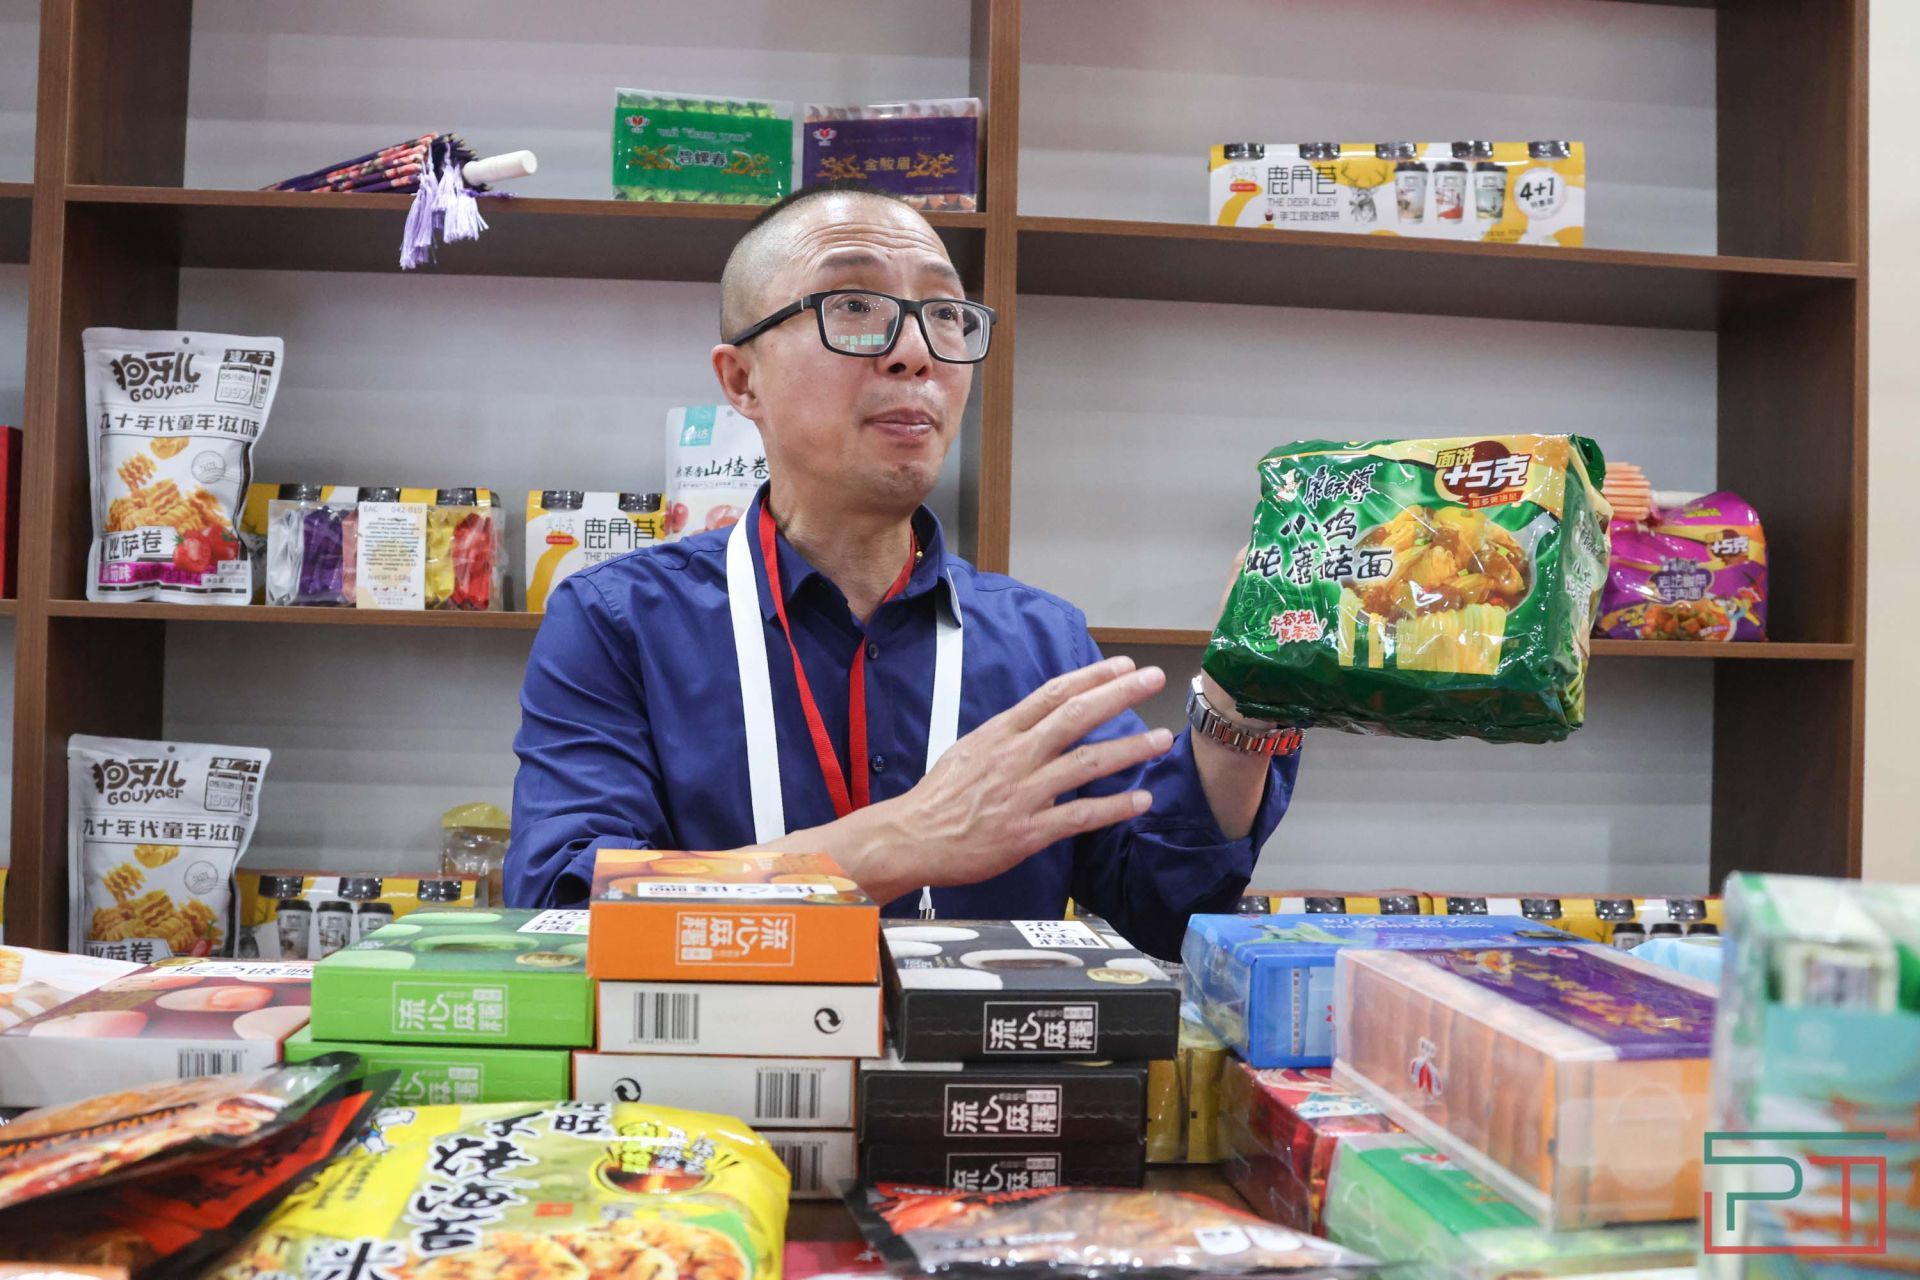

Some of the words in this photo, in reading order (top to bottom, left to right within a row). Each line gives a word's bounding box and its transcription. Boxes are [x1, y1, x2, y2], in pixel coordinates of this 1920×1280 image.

[1519, 177, 1555, 202] 4+1
[1267, 198, 1285, 207] THE
[1436, 448, 1475, 469] 面饼
[1443, 455, 1531, 488] +5克
[1280, 507, 1358, 542] 小鸡
[584, 552, 602, 562] THE
[1246, 542, 1394, 586] 炖蘑菇面
